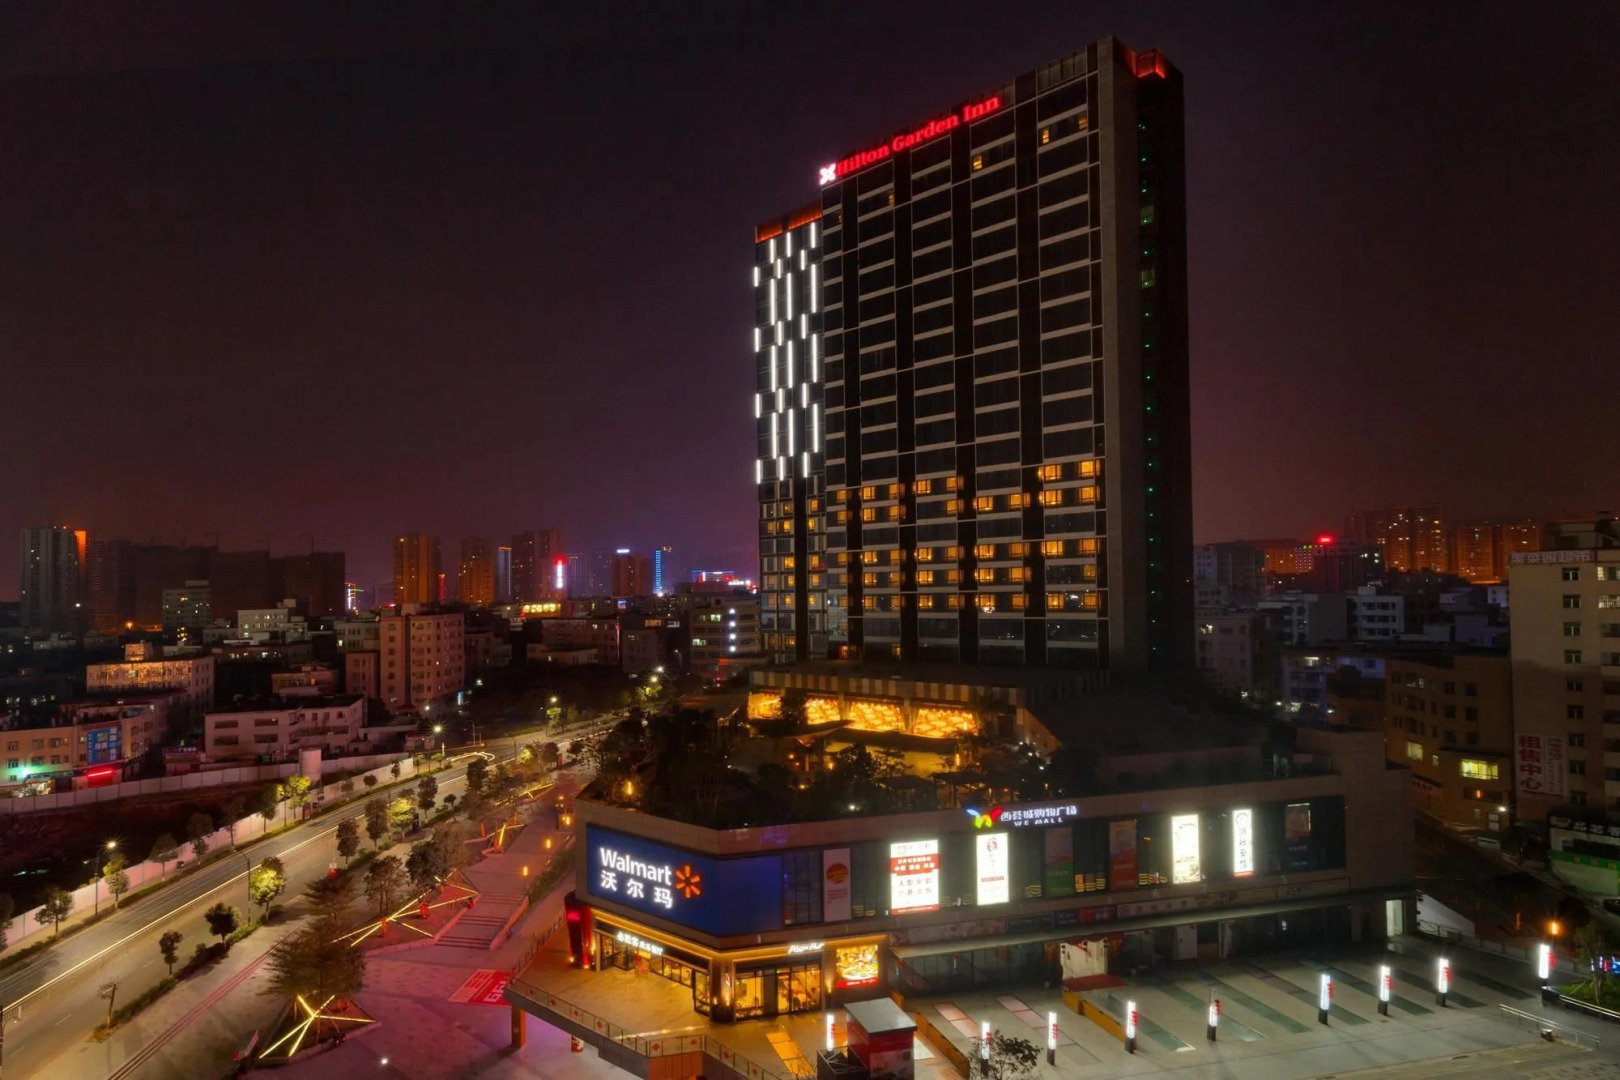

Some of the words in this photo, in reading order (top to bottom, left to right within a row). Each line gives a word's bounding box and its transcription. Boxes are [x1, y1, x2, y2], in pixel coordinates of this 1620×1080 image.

[837, 145, 890, 176] Hilton
[892, 113, 960, 152] Garden
[962, 96, 1000, 122] Inn
[600, 847, 672, 886] Walmart
[601, 869, 673, 909] 沃尔玛
